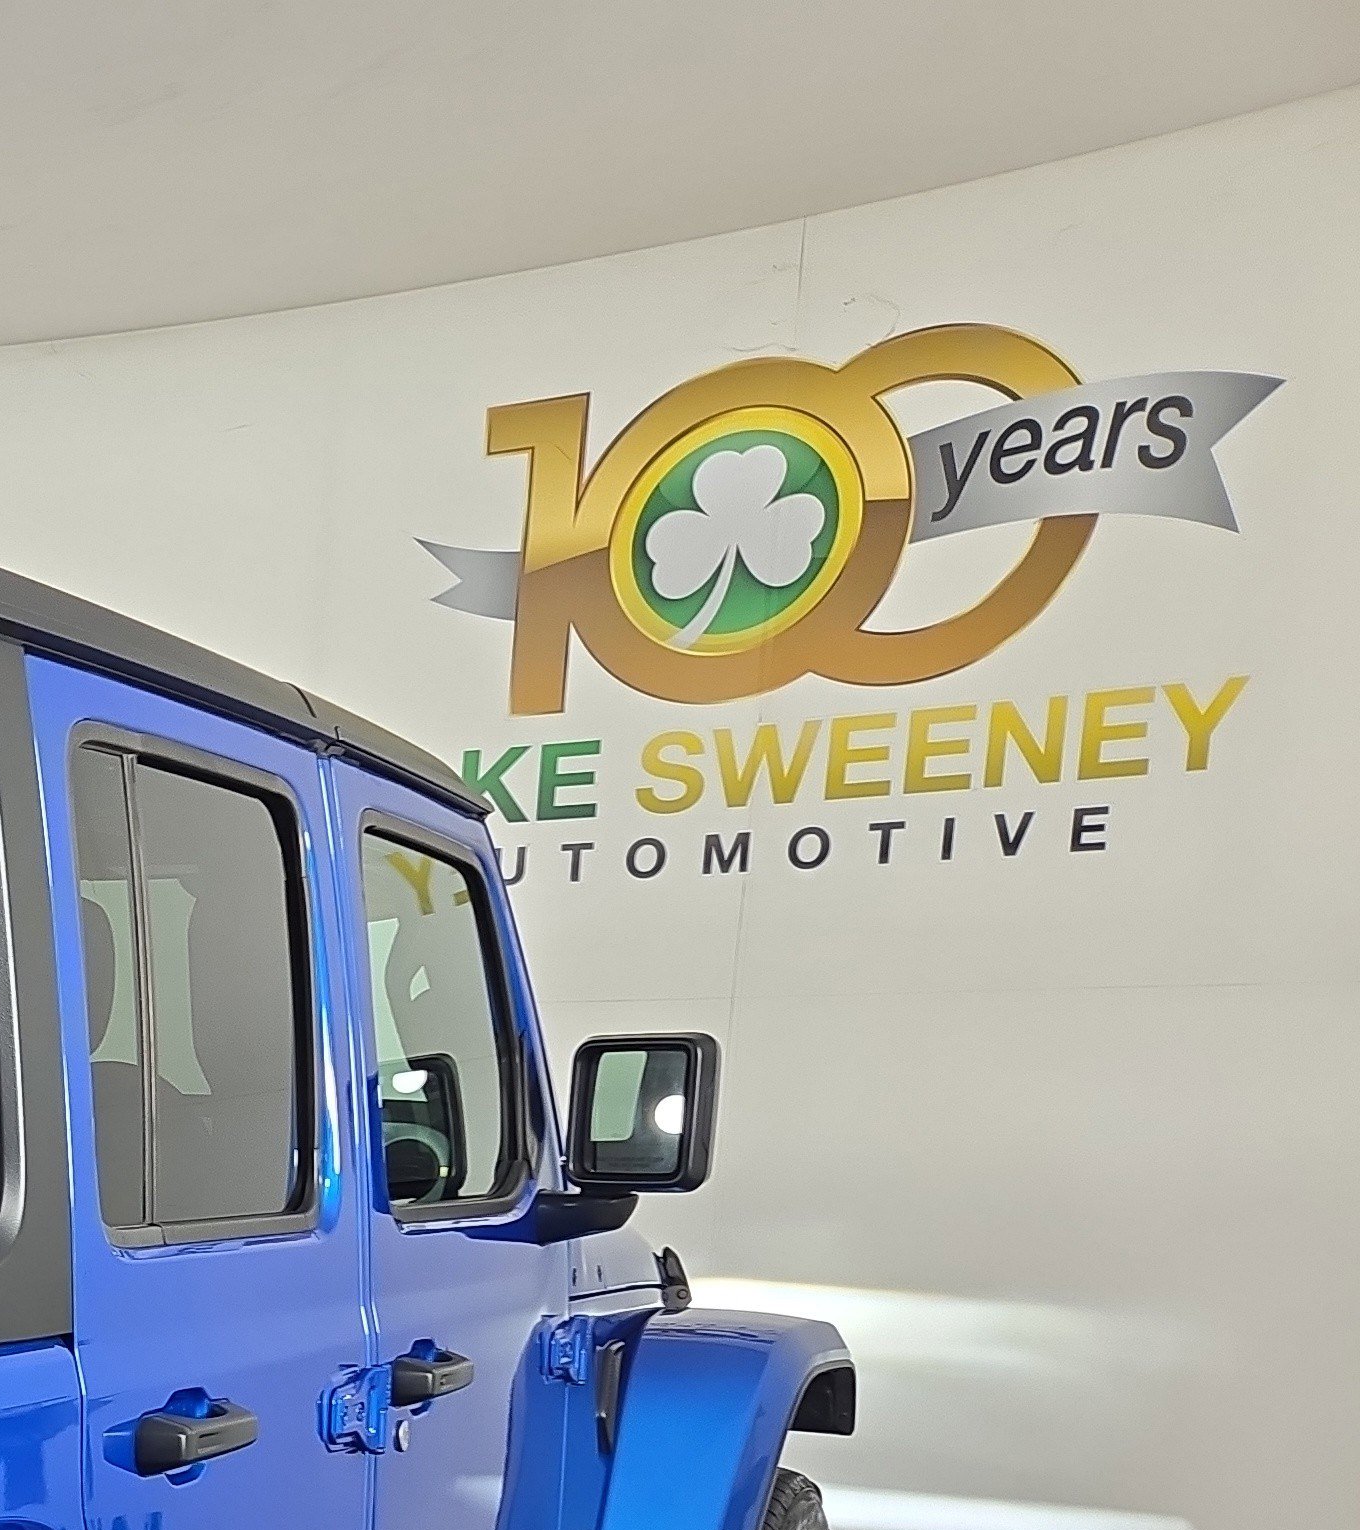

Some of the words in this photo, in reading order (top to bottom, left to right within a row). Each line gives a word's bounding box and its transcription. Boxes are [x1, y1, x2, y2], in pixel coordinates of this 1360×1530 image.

[931, 391, 1194, 522] years
[461, 739, 602, 824] KE
[635, 675, 1250, 815] SWEENEY
[494, 805, 1110, 887] UTOMOTIVE
